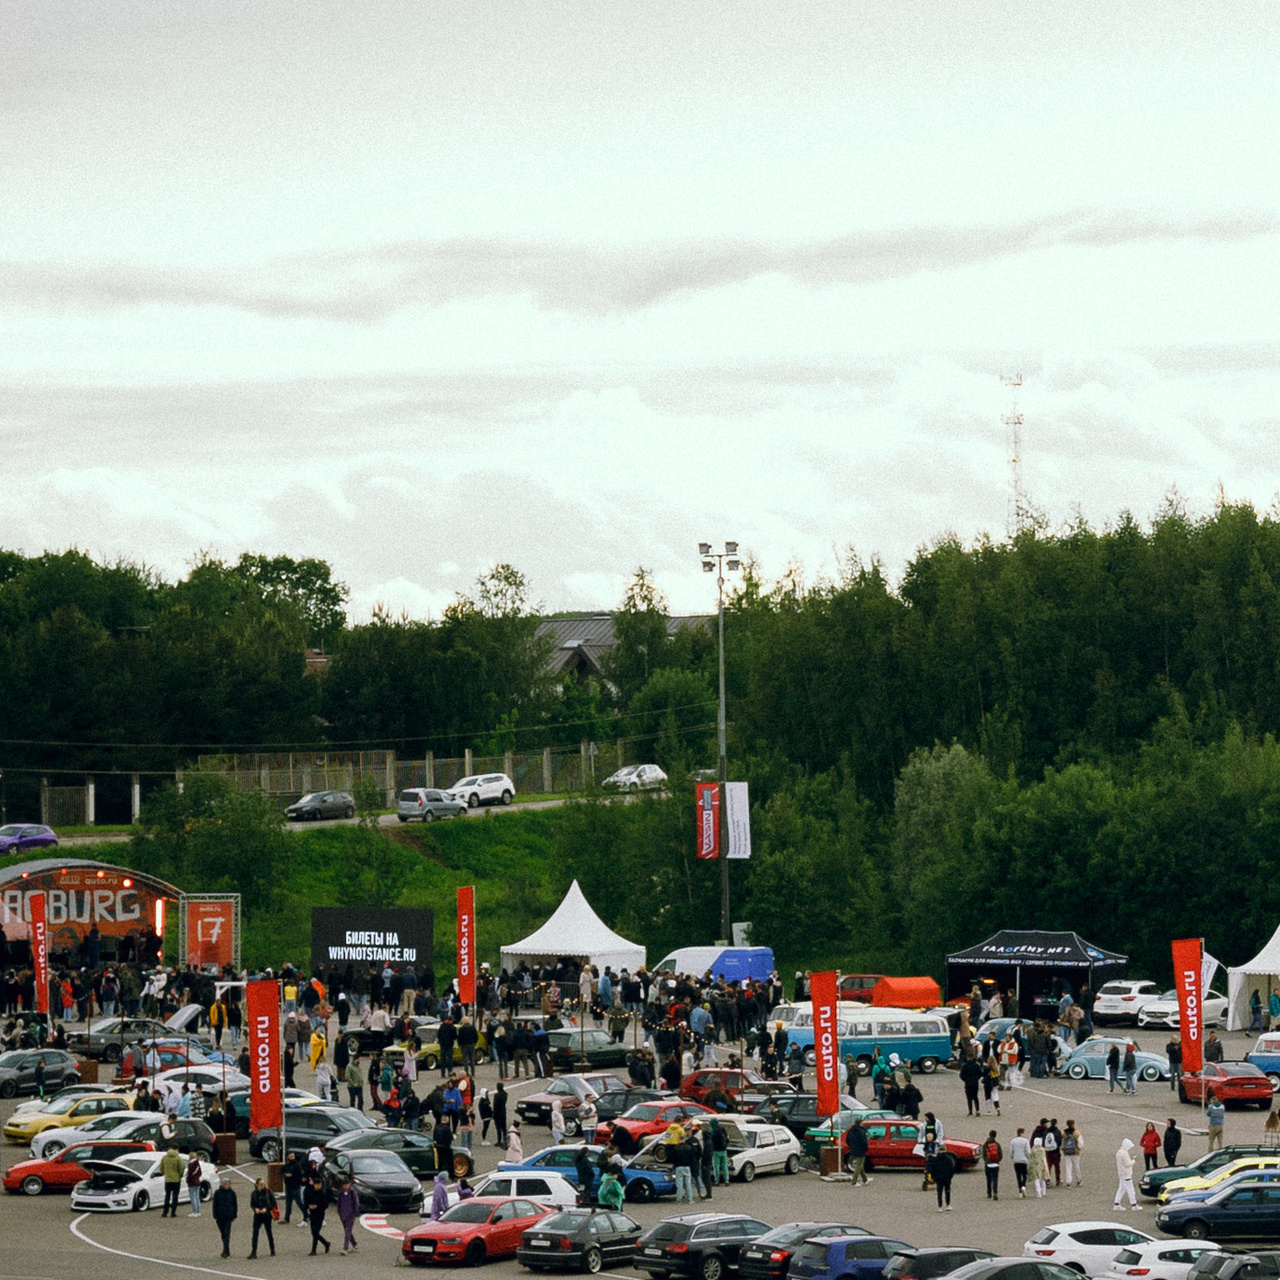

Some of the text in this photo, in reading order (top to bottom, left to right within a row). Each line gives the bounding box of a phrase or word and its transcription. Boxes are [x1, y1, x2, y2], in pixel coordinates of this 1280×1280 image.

[85, 877, 118, 885] auto.ru
[0, 889, 140, 924] ABURG
[329, 946, 417, 962] WHYNOTSTANCE.RU
[345, 931, 399, 946] БИЛЕТЫ НА
[461, 915, 469, 977] auto.ru
[982, 945, 1045, 954] ГАЛОГЕНУ
[1047, 947, 1072, 955] НЕТ
[1184, 970, 1198, 1040] auto.ru
[257, 1016, 271, 1093] auto.ru
[820, 1005, 834, 1082] auto.ru
